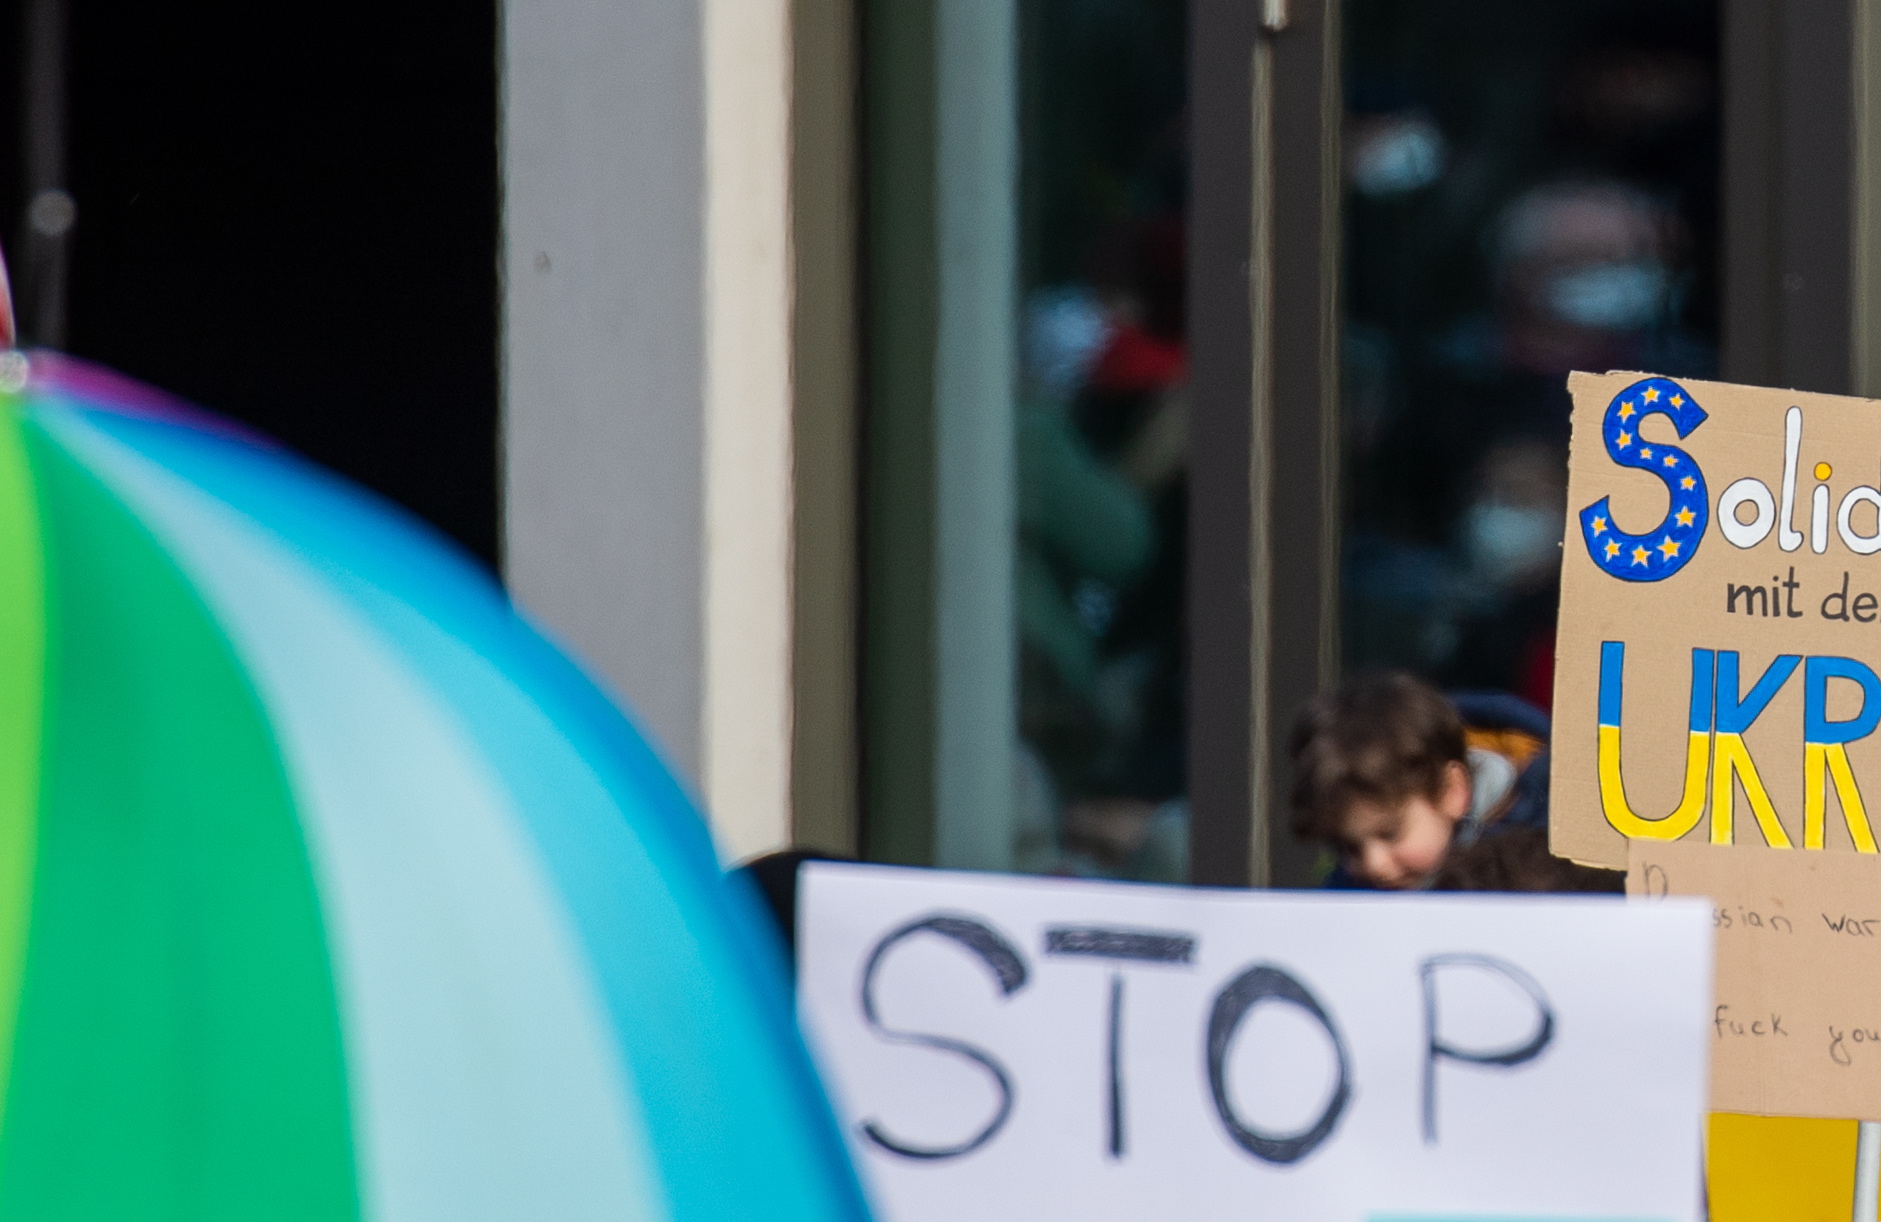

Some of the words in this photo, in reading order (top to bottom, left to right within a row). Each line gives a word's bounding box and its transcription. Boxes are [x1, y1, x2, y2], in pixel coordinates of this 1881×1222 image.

[1726, 567, 1804, 618] mit
[857, 909, 1557, 1166] STOP
[1713, 1004, 1789, 1039] fuck
